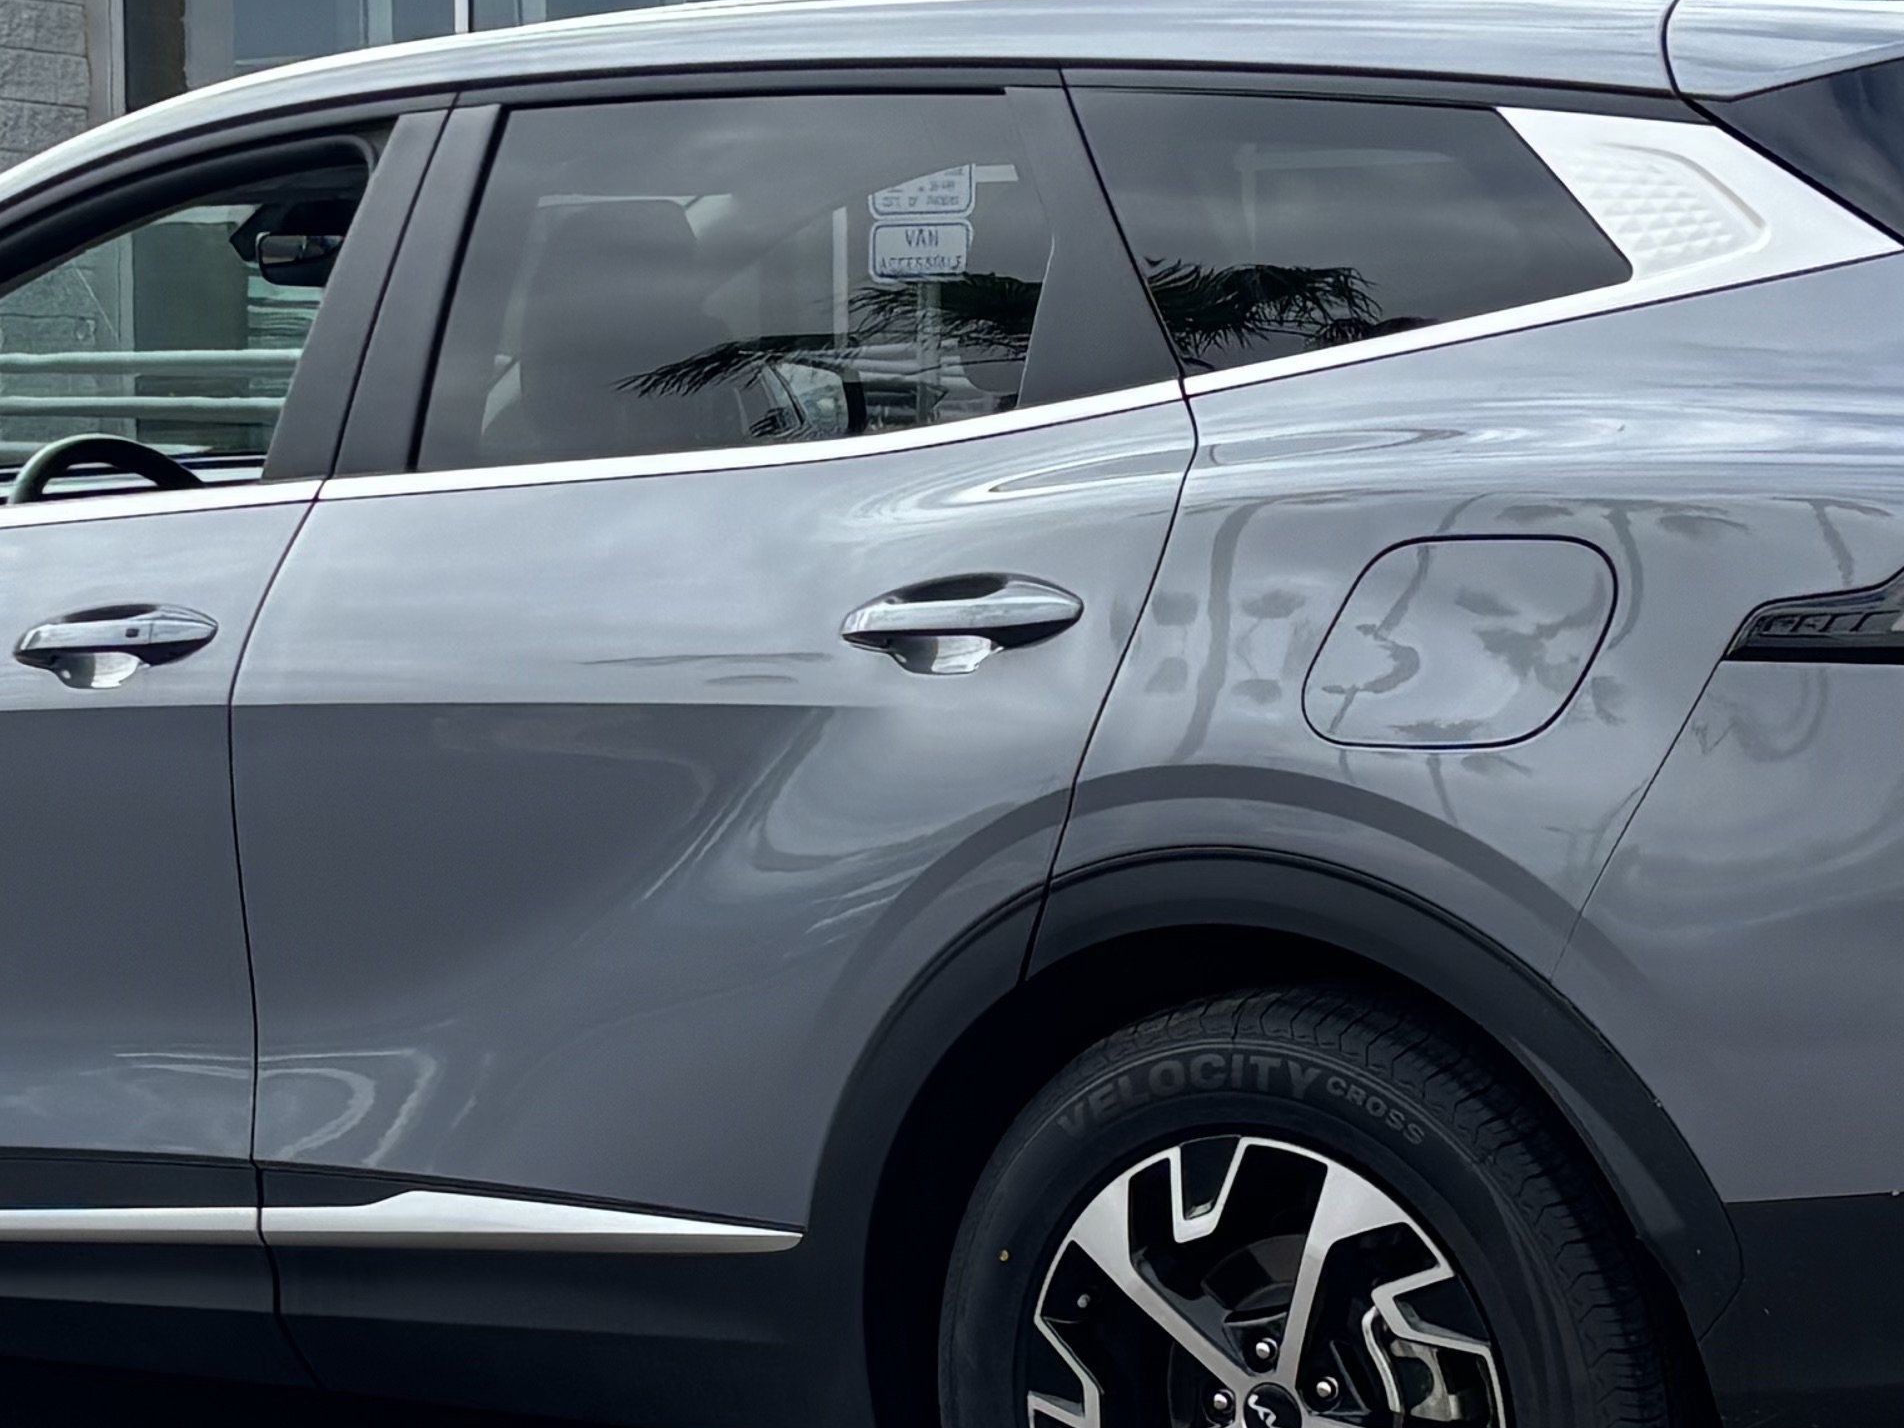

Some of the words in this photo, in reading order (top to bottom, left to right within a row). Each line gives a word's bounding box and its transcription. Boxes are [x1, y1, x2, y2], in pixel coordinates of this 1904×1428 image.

[904, 228, 939, 248] VAN
[1054, 1052, 1322, 1134] VELOCITY
[1325, 1075, 1426, 1146] CROSS
